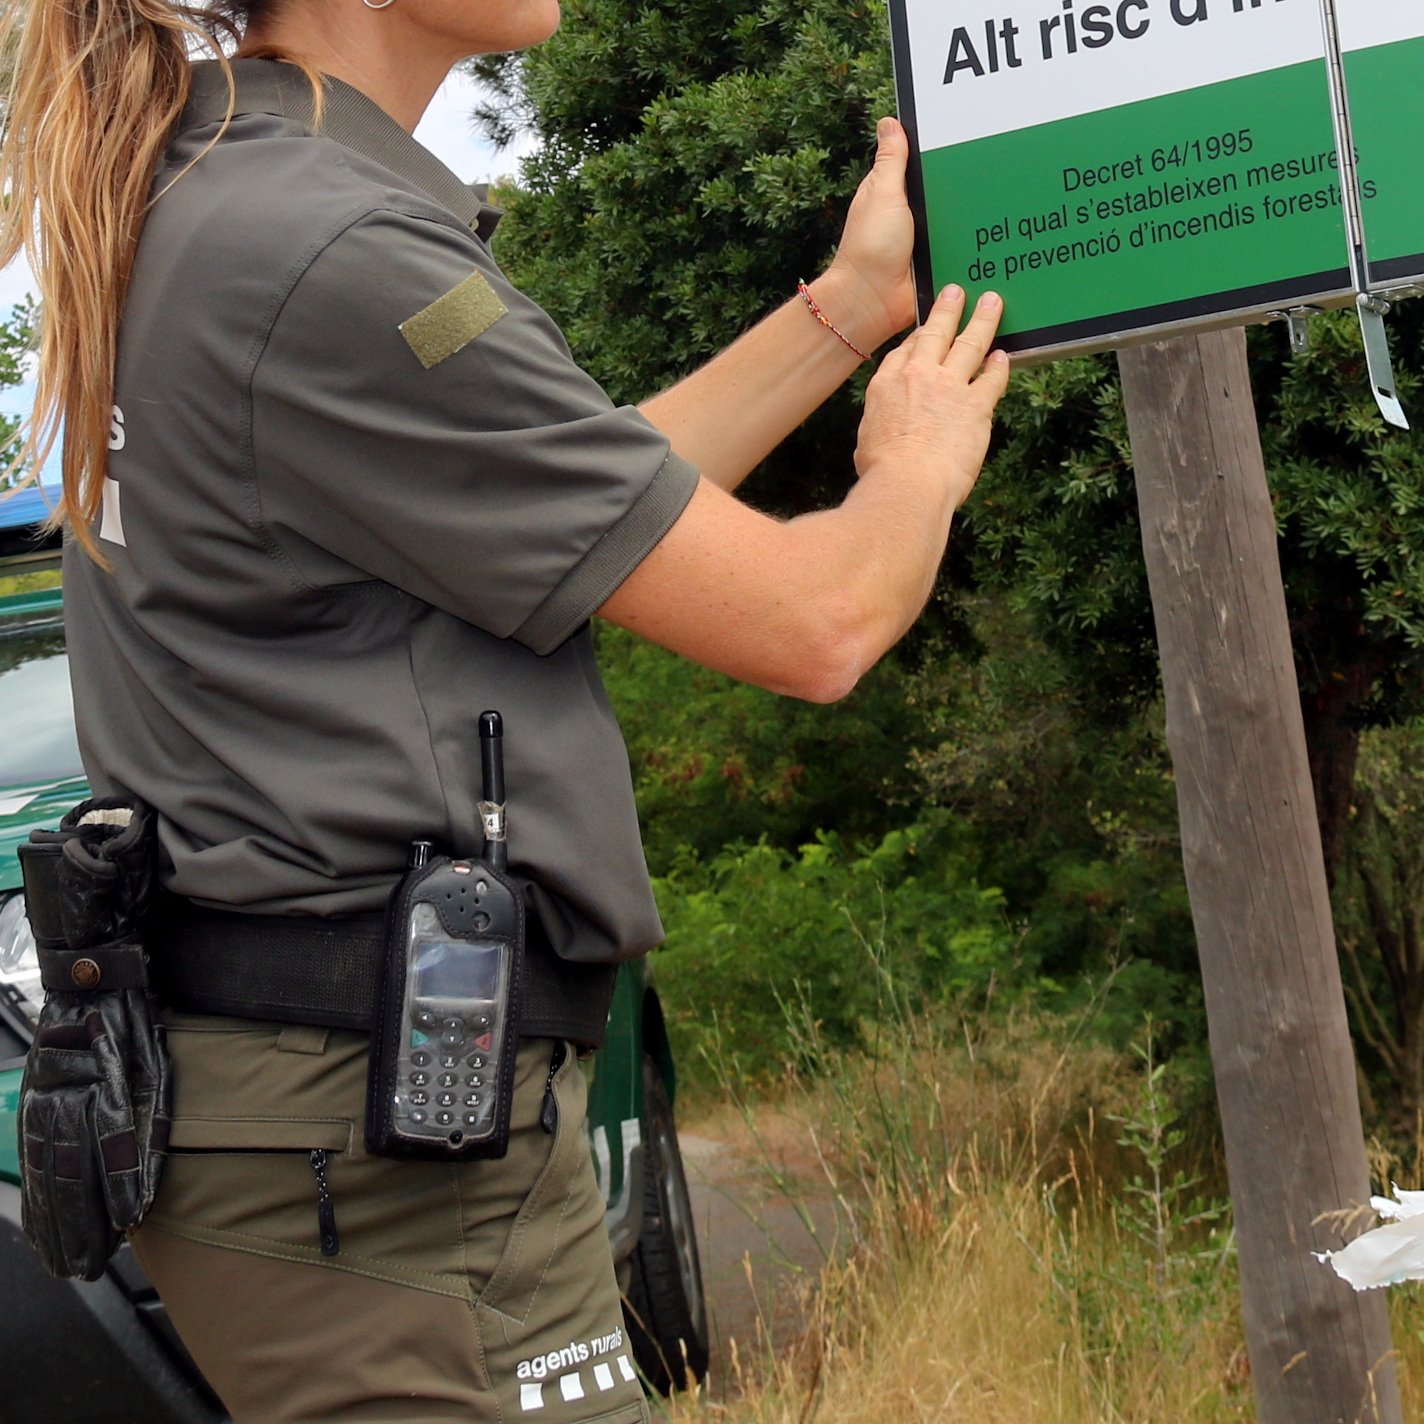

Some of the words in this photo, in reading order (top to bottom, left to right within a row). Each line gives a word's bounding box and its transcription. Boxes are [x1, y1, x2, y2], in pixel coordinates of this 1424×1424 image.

[942, 17, 1023, 85] Alt
[1062, 154, 1144, 192] Decret
[1151, 128, 1253, 173] 64/1995
[967, 257, 996, 282] de
[1004, 229, 1122, 281] prevenció
[1262, 176, 1377, 220] forestls
[975, 214, 1010, 252] pel
[1018, 203, 1068, 241] qual
[516, 1342, 589, 1379] agents
[590, 1326, 622, 1356] rurals
